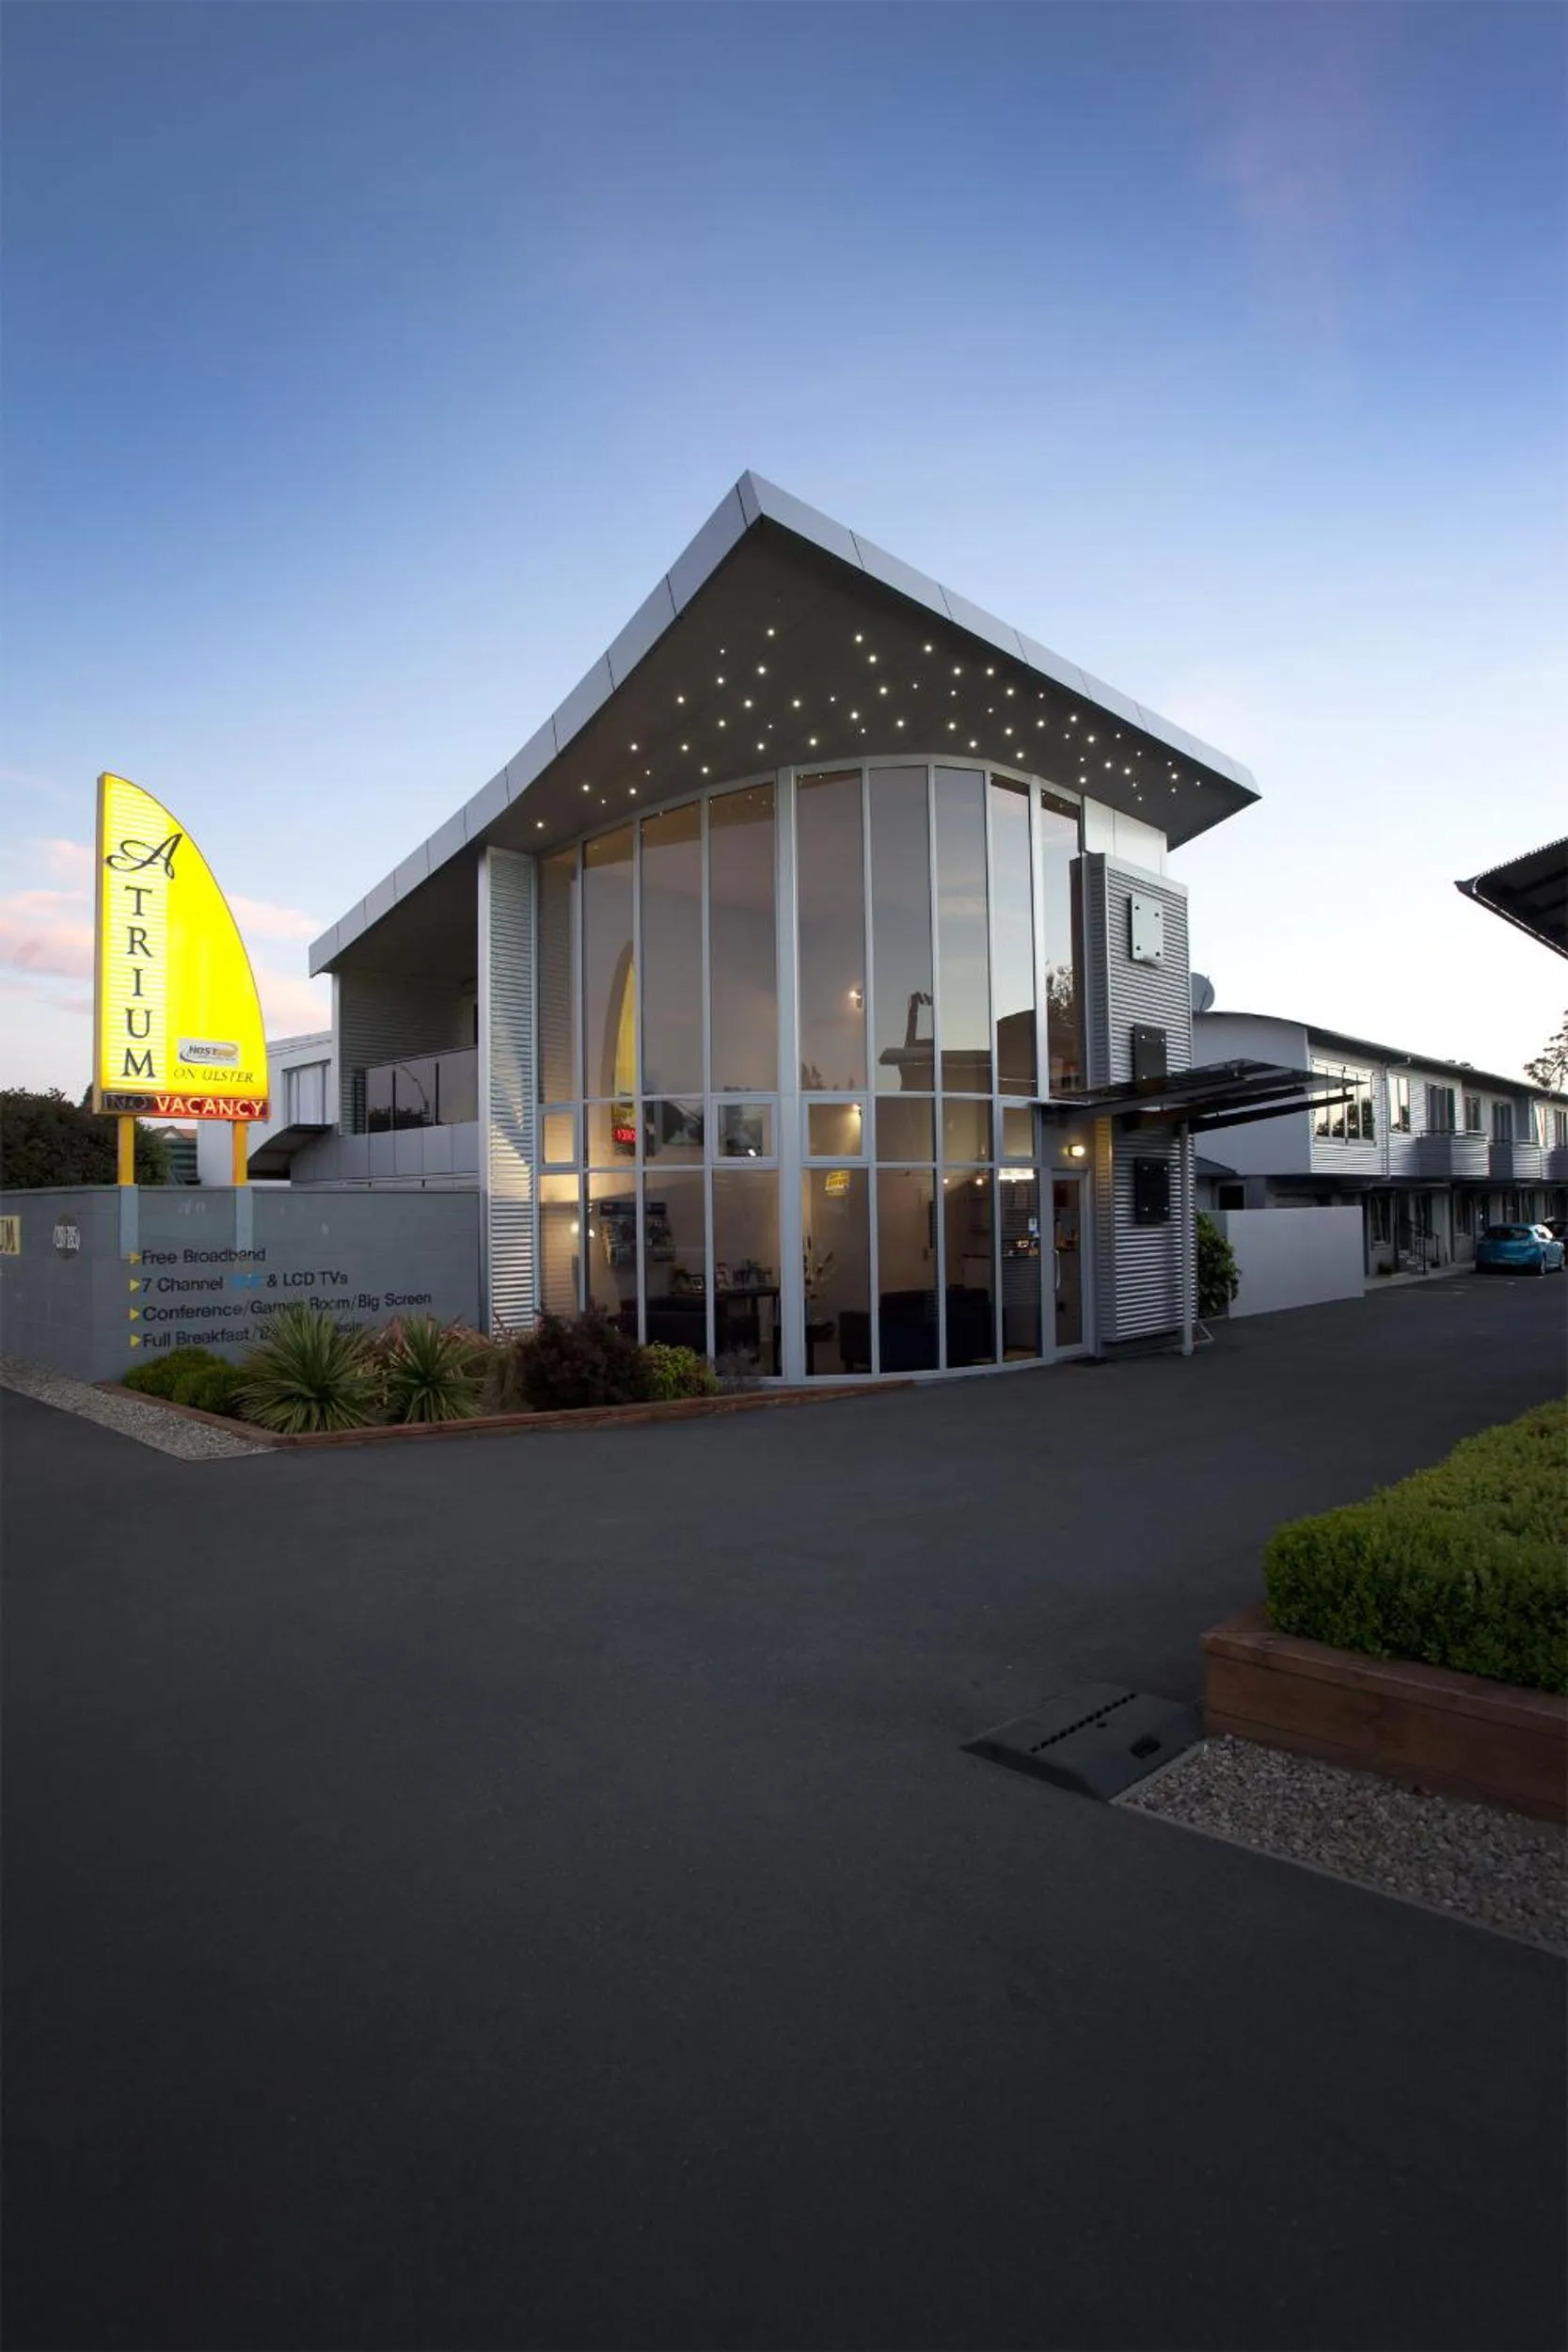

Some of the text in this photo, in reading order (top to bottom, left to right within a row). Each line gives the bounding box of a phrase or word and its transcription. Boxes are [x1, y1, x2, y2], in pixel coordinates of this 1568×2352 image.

[106, 834, 183, 1079] ATRIUM
[173, 1067, 254, 1083] ON ULSTER
[155, 1095, 264, 1117] VACANCY
[142, 1248, 266, 1264] Free Broadband
[142, 1278, 152, 1293] 7
[157, 1276, 223, 1293] Channel
[266, 1273, 278, 1289] &
[283, 1272, 314, 1287] LCD
[320, 1271, 348, 1285] TVs
[384, 1293, 432, 1308] Screen
[142, 1331, 171, 1348] Full
